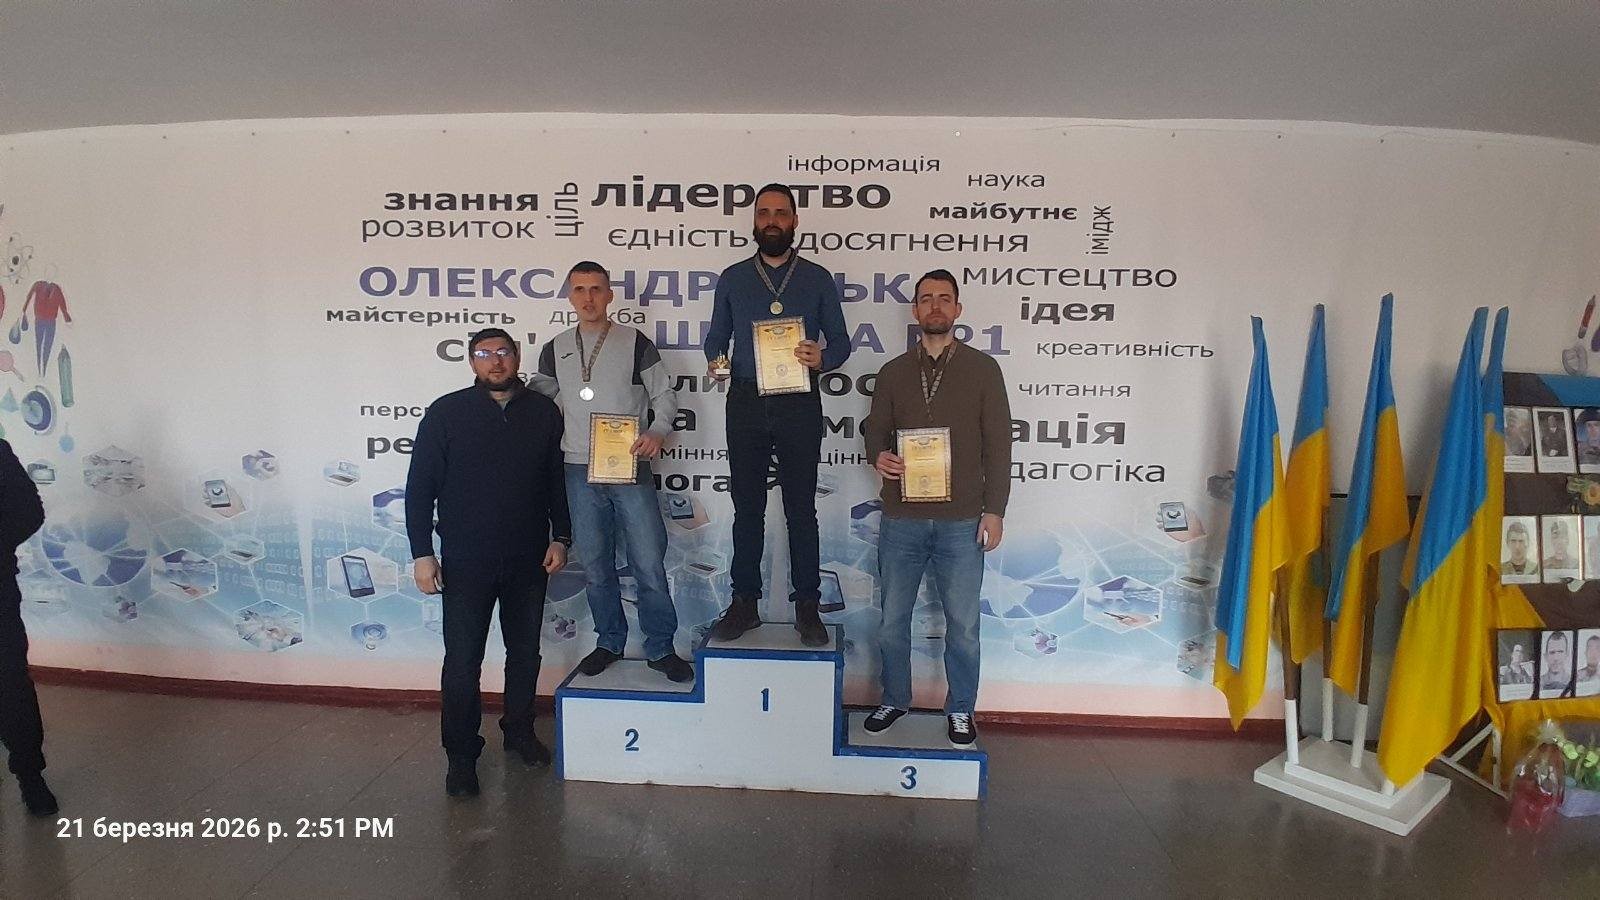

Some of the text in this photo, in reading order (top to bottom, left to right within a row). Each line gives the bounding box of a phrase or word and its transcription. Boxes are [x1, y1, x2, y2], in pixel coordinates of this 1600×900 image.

[788, 155, 941, 174] інформація
[967, 173, 1045, 188] наука
[383, 192, 539, 212] знання
[590, 175, 892, 216] лідертво
[546, 181, 584, 237] ціль
[929, 202, 1078, 222] майбутнє
[361, 219, 536, 243] розвиток
[607, 223, 749, 251] єдність
[1085, 203, 1115, 255] імідж
[795, 230, 1029, 254] досягнення
[962, 266, 1178, 290] мистецтво
[326, 306, 516, 327] майстерність
[549, 308, 647, 326] дрба
[1020, 296, 1115, 322] ідея
[1036, 340, 1215, 359] креативність
[1017, 383, 1132, 398] читання
[650, 445, 729, 461] міння
[1010, 458, 1166, 483] дагогіка
[760, 688, 770, 712] 1
[624, 728, 640, 752] 2
[900, 766, 918, 790] 3
